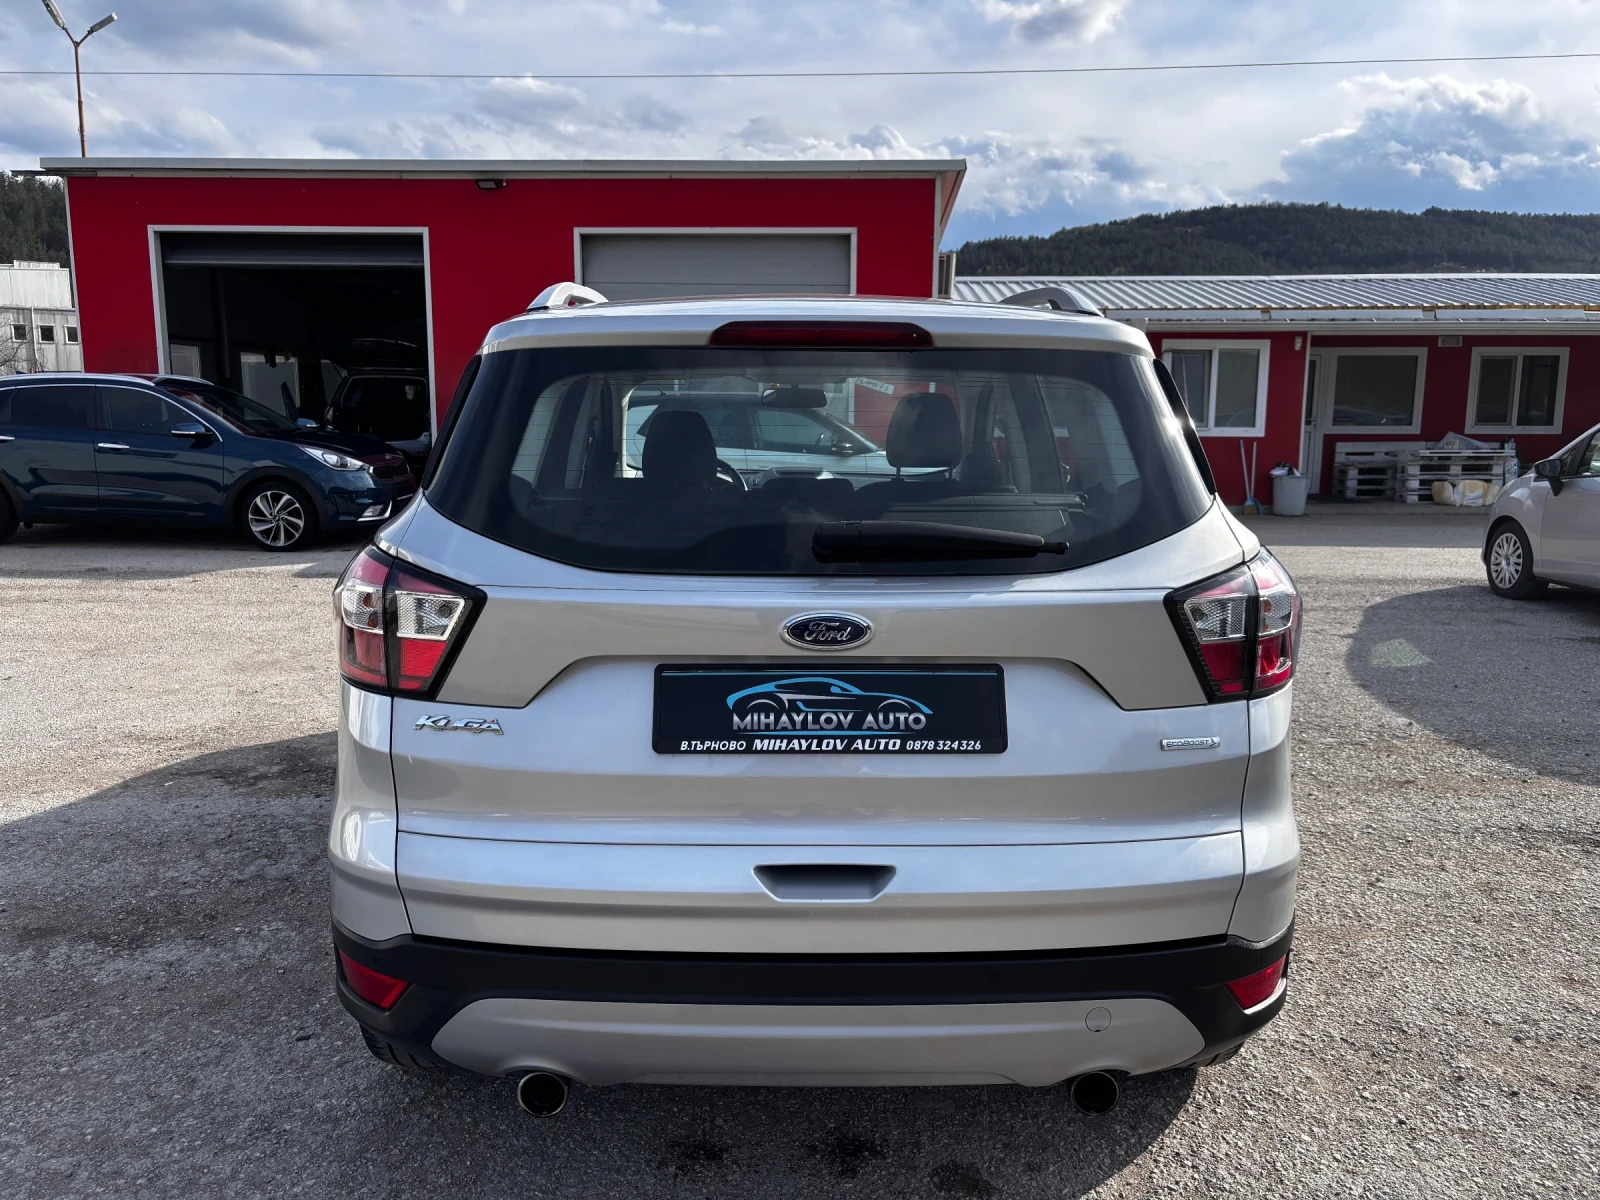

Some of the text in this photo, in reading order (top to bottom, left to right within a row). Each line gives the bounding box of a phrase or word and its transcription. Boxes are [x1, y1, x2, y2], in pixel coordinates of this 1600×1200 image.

[803, 620, 851, 641] Ford
[412, 714, 504, 735] KUGA
[732, 711, 928, 731] MIHAYLOV AUTO
[752, 738, 848, 751] MIHAYLOV
[850, 738, 901, 751] AUTO
[906, 740, 935, 751] 0878
